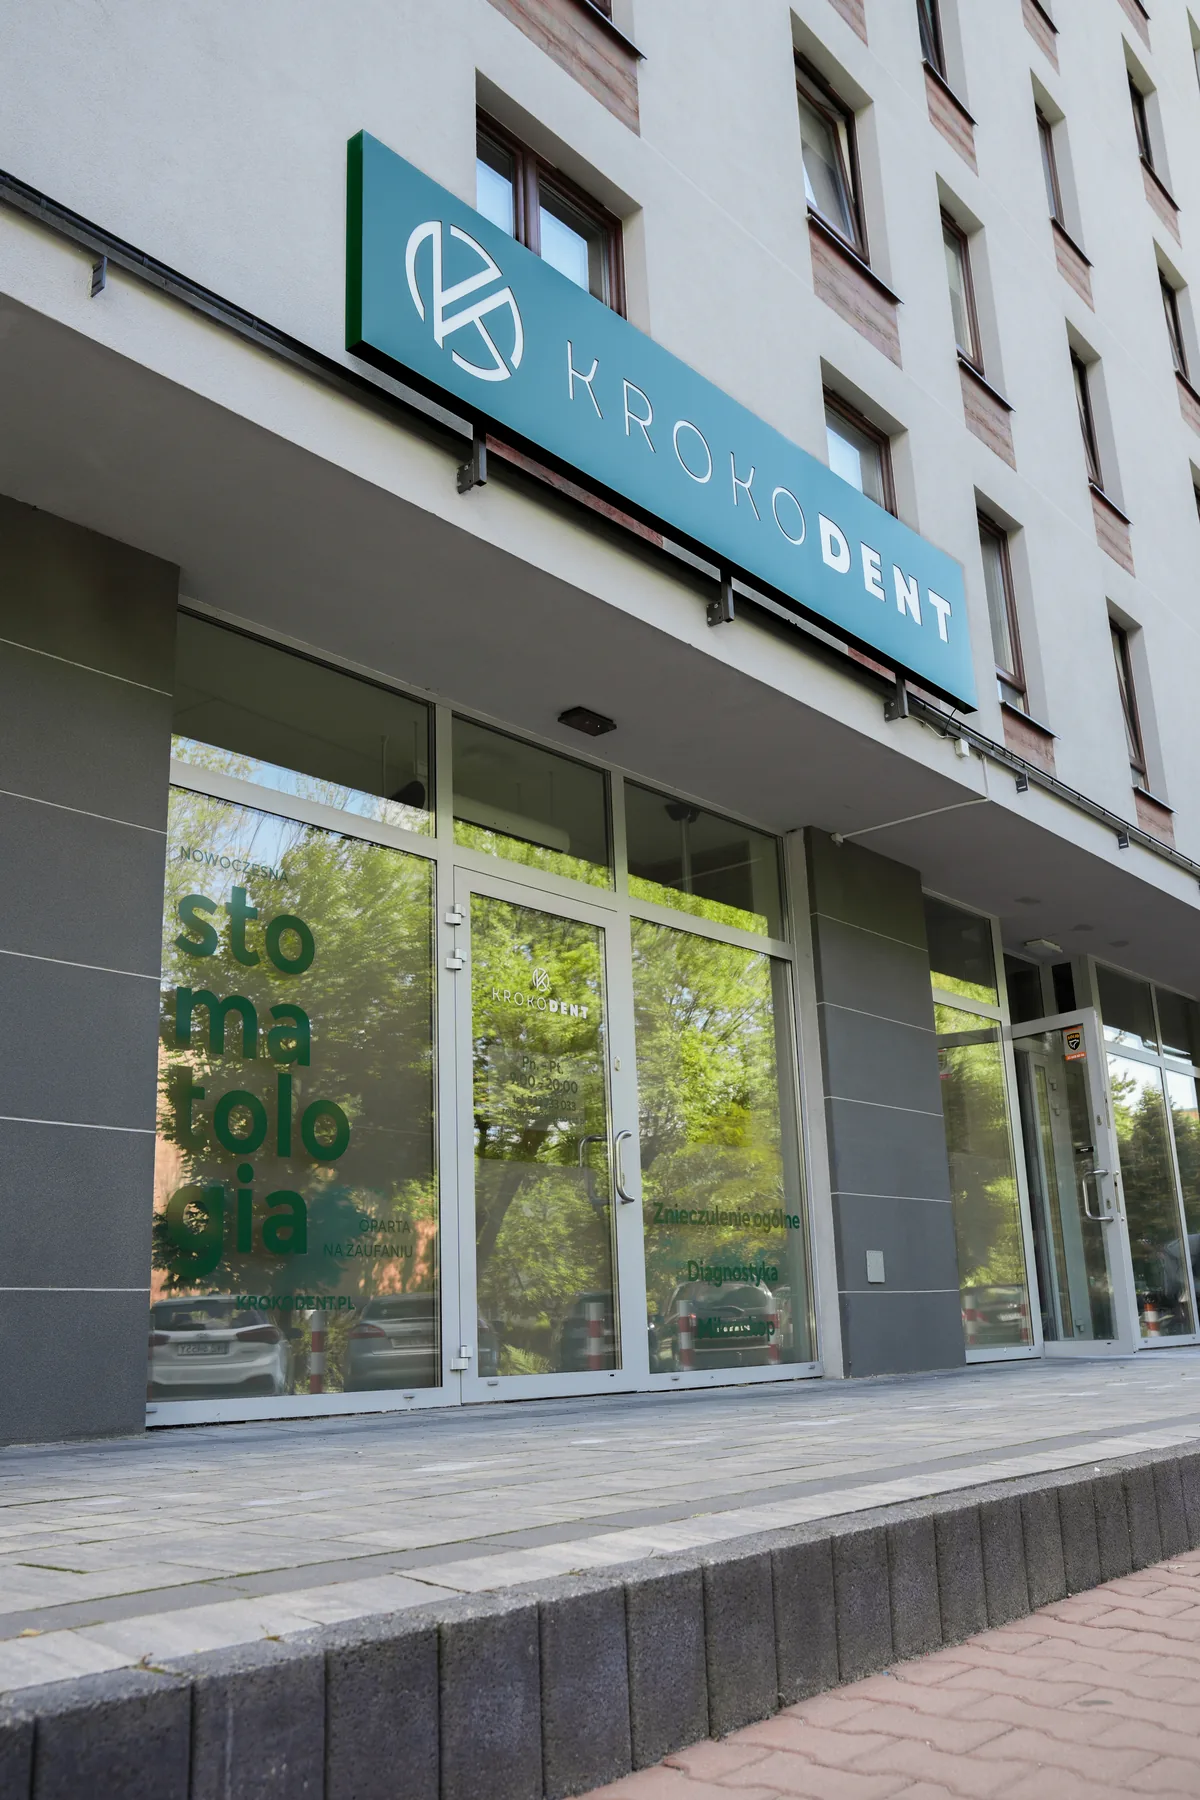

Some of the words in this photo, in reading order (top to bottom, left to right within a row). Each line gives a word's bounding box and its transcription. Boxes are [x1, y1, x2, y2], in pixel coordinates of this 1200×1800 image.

[567, 340, 953, 643] KROKODENT
[180, 845, 289, 883] NOWOCZESNA
[174, 885, 315, 975] sto
[492, 987, 589, 1019] KROKODENT
[175, 986, 311, 1067] ma
[545, 1077, 578, 1094] 20:00
[170, 1066, 350, 1161] tolo
[166, 1163, 308, 1279] gia
[359, 1219, 411, 1233] OPARTA
[652, 1202, 750, 1226] Znieczulenie
[751, 1209, 800, 1233] ogólne
[323, 1243, 343, 1257] NA
[346, 1244, 413, 1258] ZAUFANIU
[687, 1260, 778, 1287] Diagnostyka
[236, 1295, 356, 1311] KROKODENT.PL
